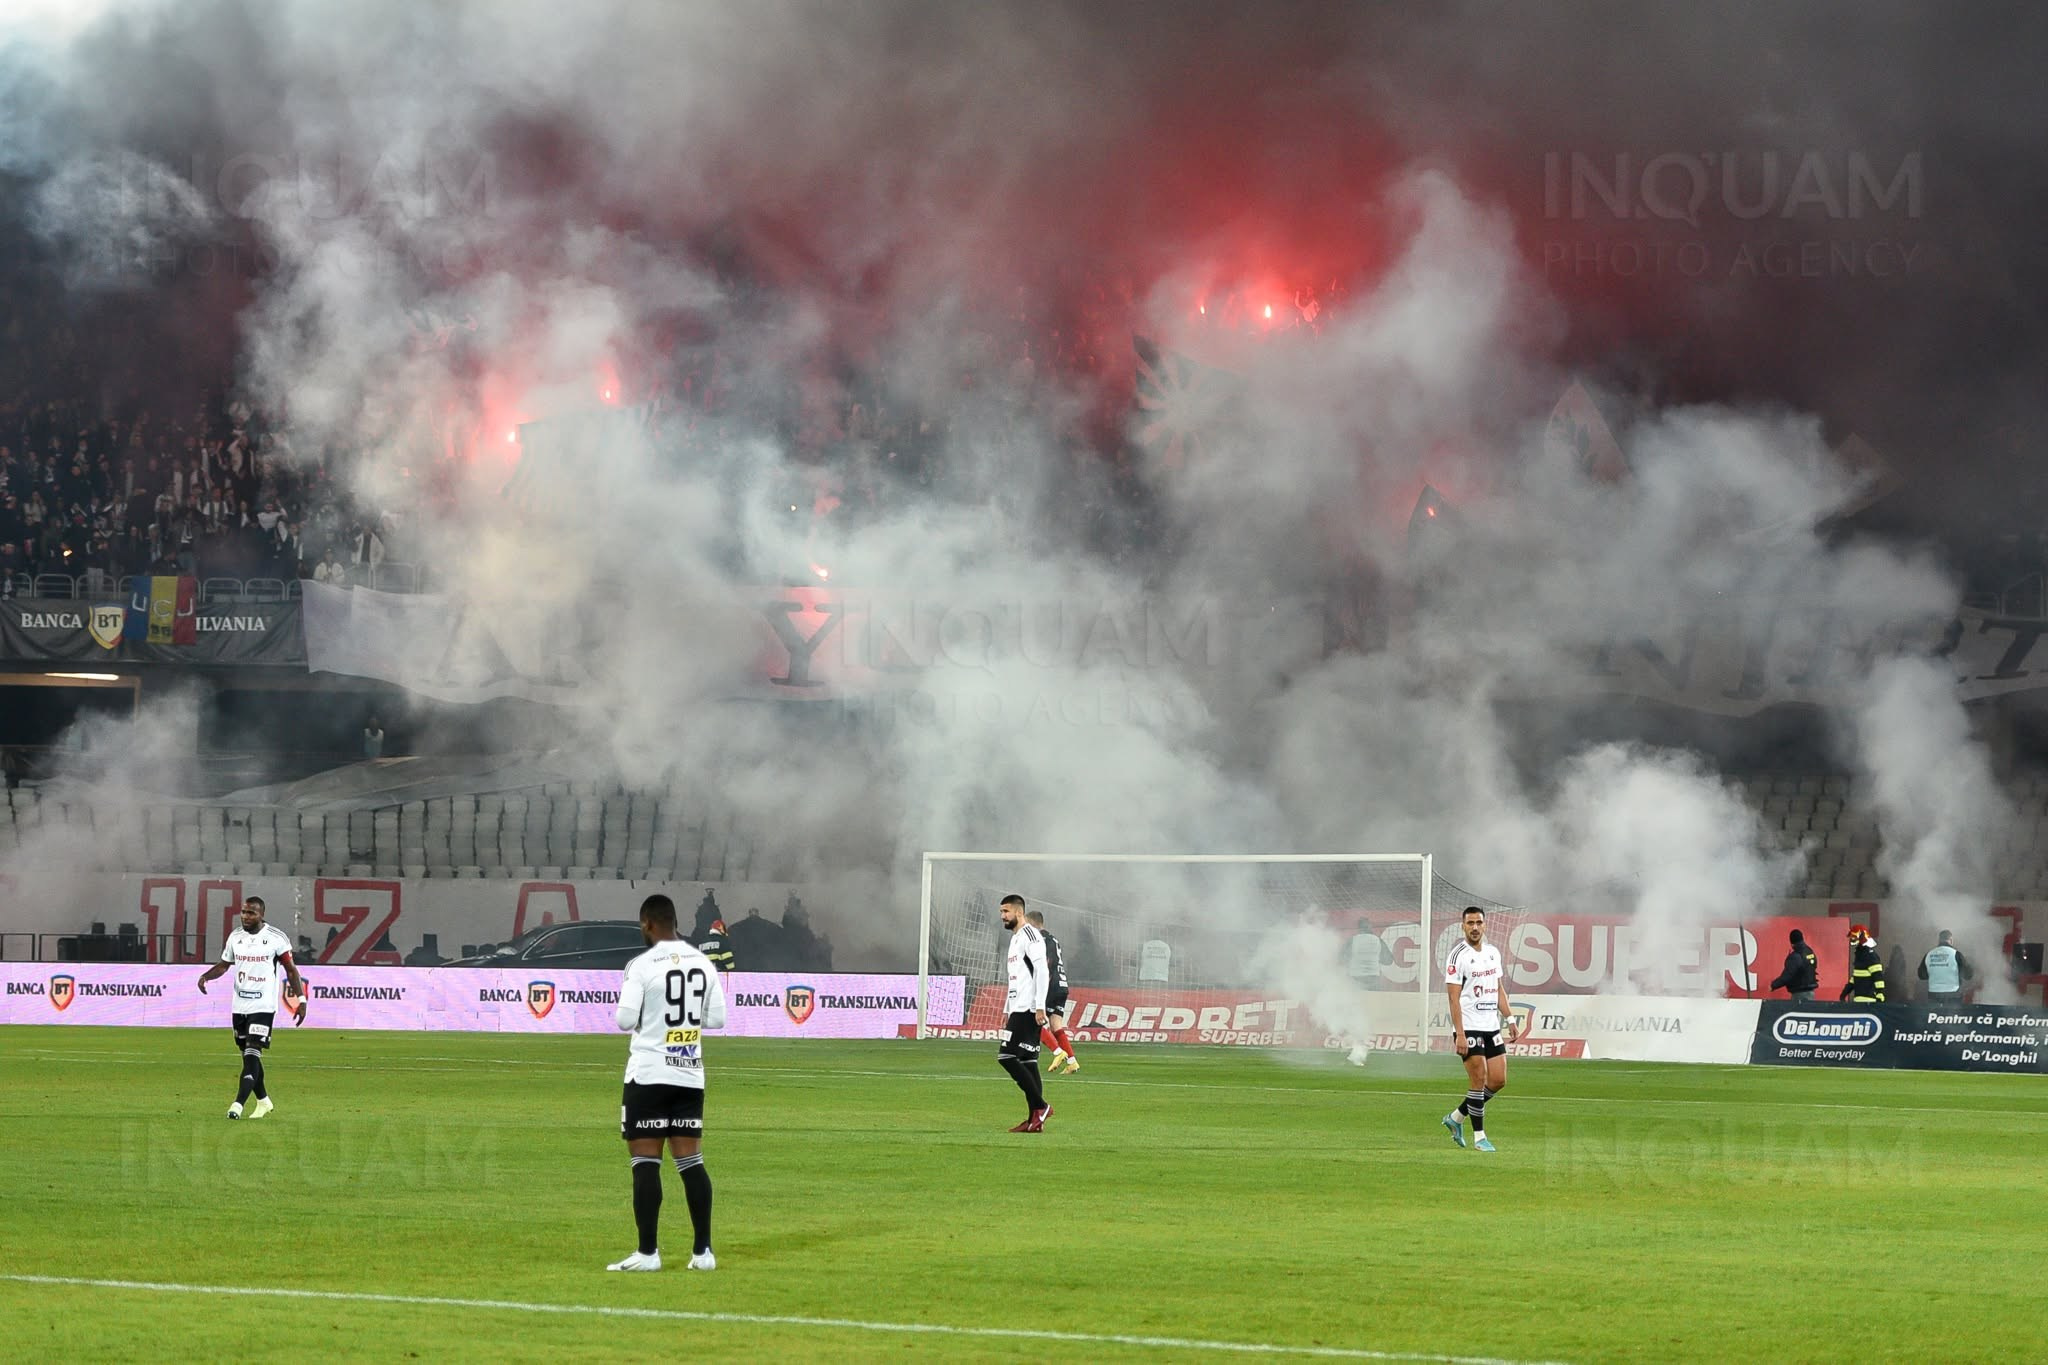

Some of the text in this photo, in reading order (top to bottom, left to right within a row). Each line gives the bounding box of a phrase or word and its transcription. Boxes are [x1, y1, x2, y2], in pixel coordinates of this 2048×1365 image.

[21, 613, 265, 631] BANCA BT ILVANIA
[1508, 922, 1758, 993] SUPER
[7, 983, 162, 997] BANCA BT TRANSILVANIA
[312, 986, 402, 1001] TRANSILVANIA
[480, 989, 621, 1004] BANCA BT TRANSILV
[664, 968, 707, 1027] 93
[735, 993, 918, 1010] BANCA BT TRANSILVANIA
[1927, 1012, 1973, 1025] Pentru
[1976, 1013, 1993, 1025] că
[665, 1029, 698, 1043] raza
[1198, 1029, 1299, 1047] SUPERBET
[1505, 1041, 1567, 1057] ERBET
[1894, 1030, 1942, 1044] inspiră
[1779, 1047, 1865, 1061] Better Everyday
